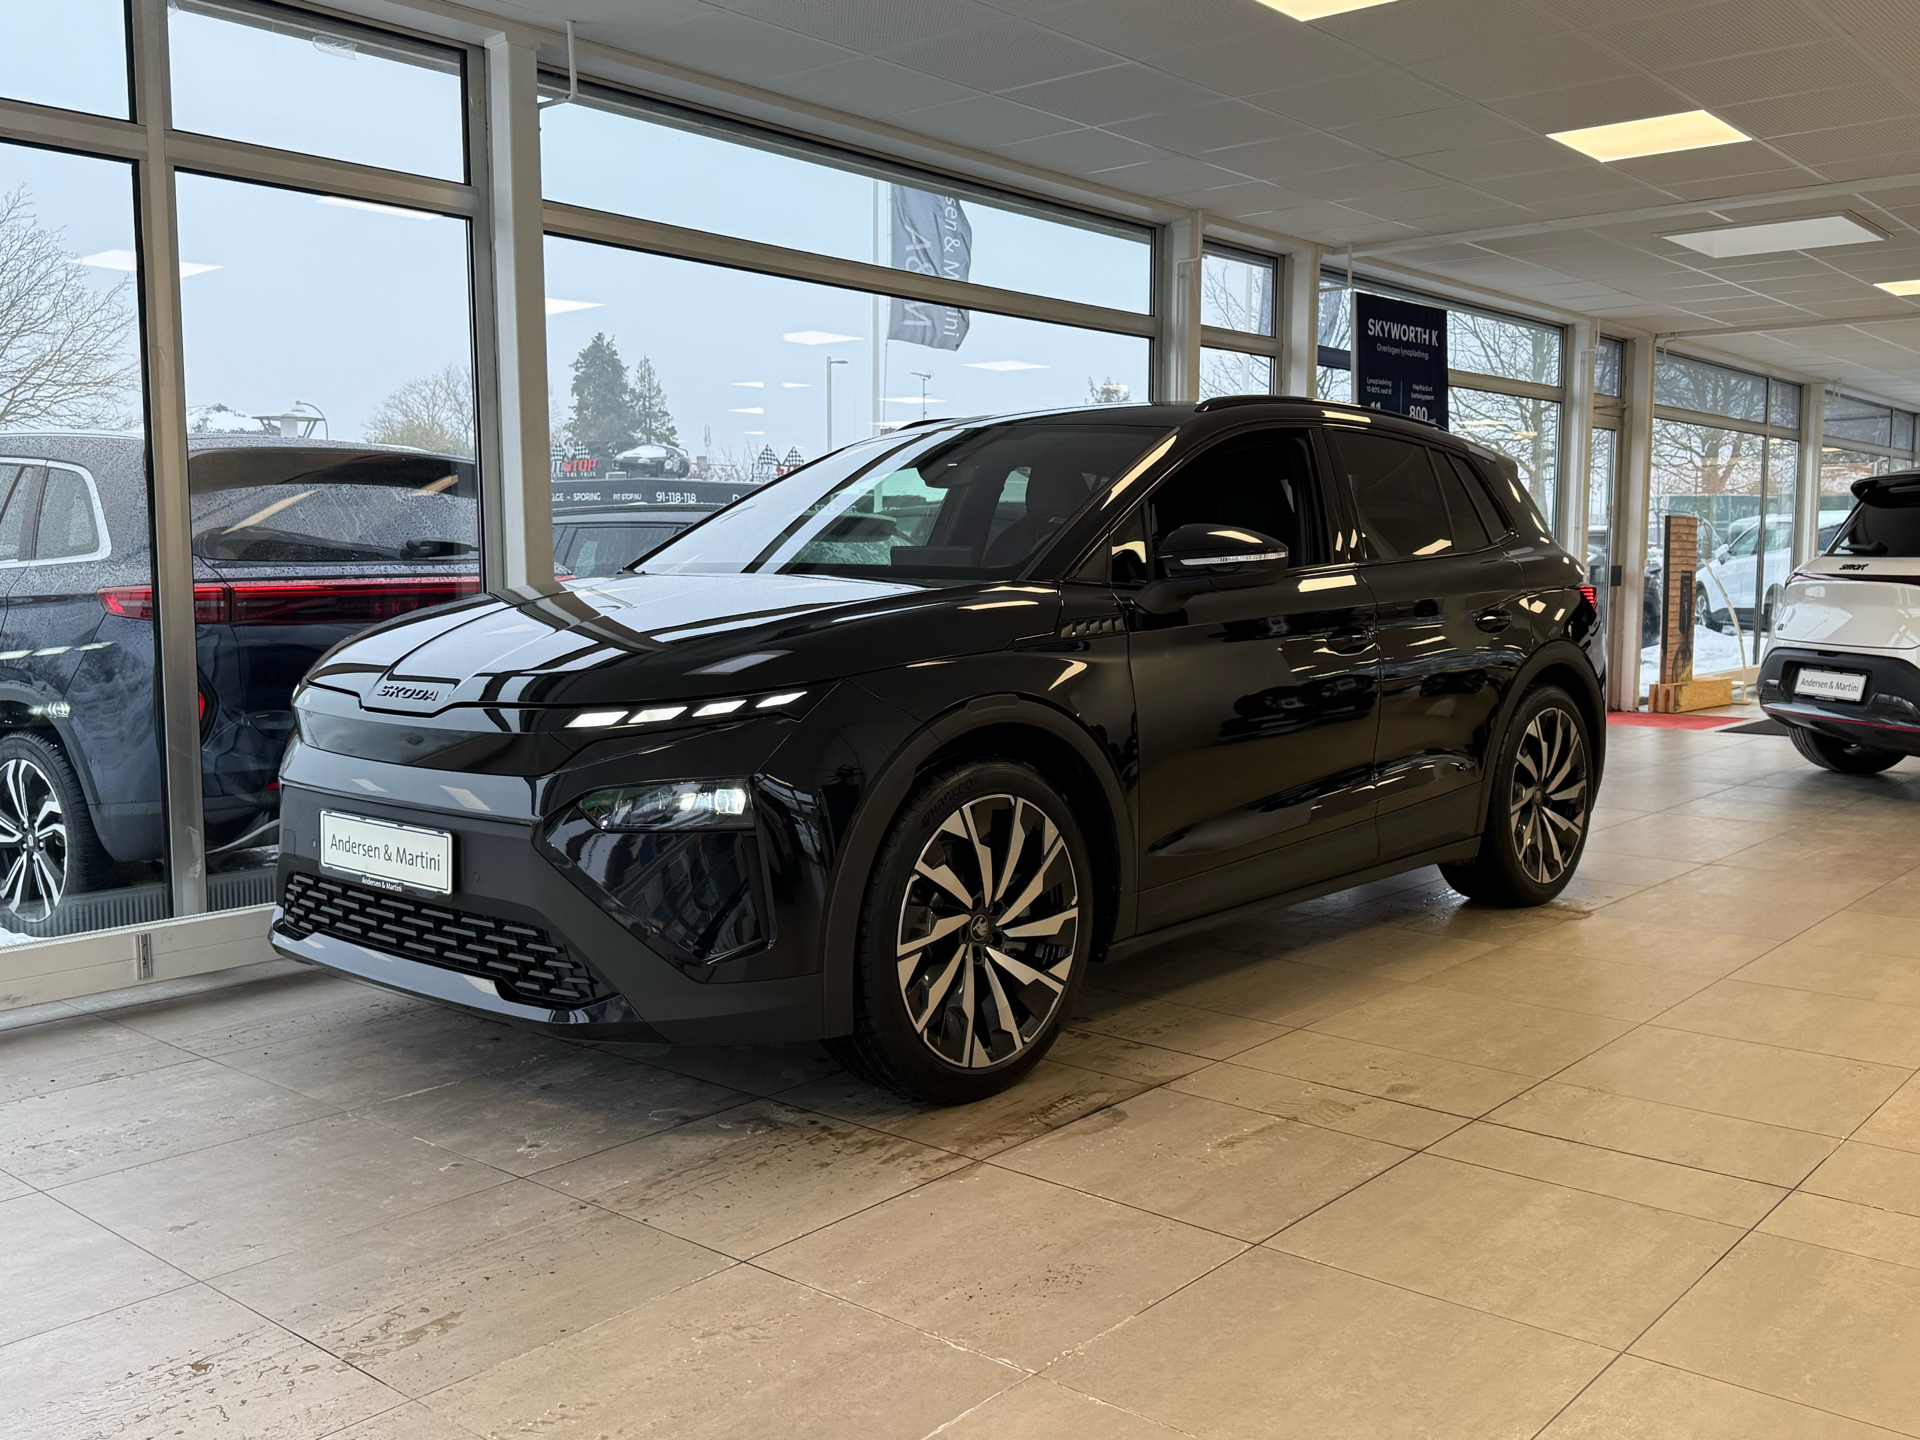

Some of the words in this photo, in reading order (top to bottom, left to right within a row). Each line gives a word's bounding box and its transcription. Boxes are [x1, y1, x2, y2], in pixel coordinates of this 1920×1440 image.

[944, 236, 961, 253] &
[1368, 318, 1429, 345] SKYWORTH
[1432, 331, 1438, 346] K
[1377, 343, 1400, 355] Overlegen
[1410, 405, 1427, 421] 800
[551, 492, 564, 502] LGE
[573, 492, 601, 501] SPORING
[656, 492, 697, 503] 91-118-118
[1800, 677, 1828, 689] Andersen
[1829, 681, 1834, 689] &
[1835, 682, 1860, 692] Martini
[330, 834, 380, 860] Andersen
[383, 844, 393, 862] &
[396, 846, 441, 872] Martini
[362, 877, 381, 888] Andersen
